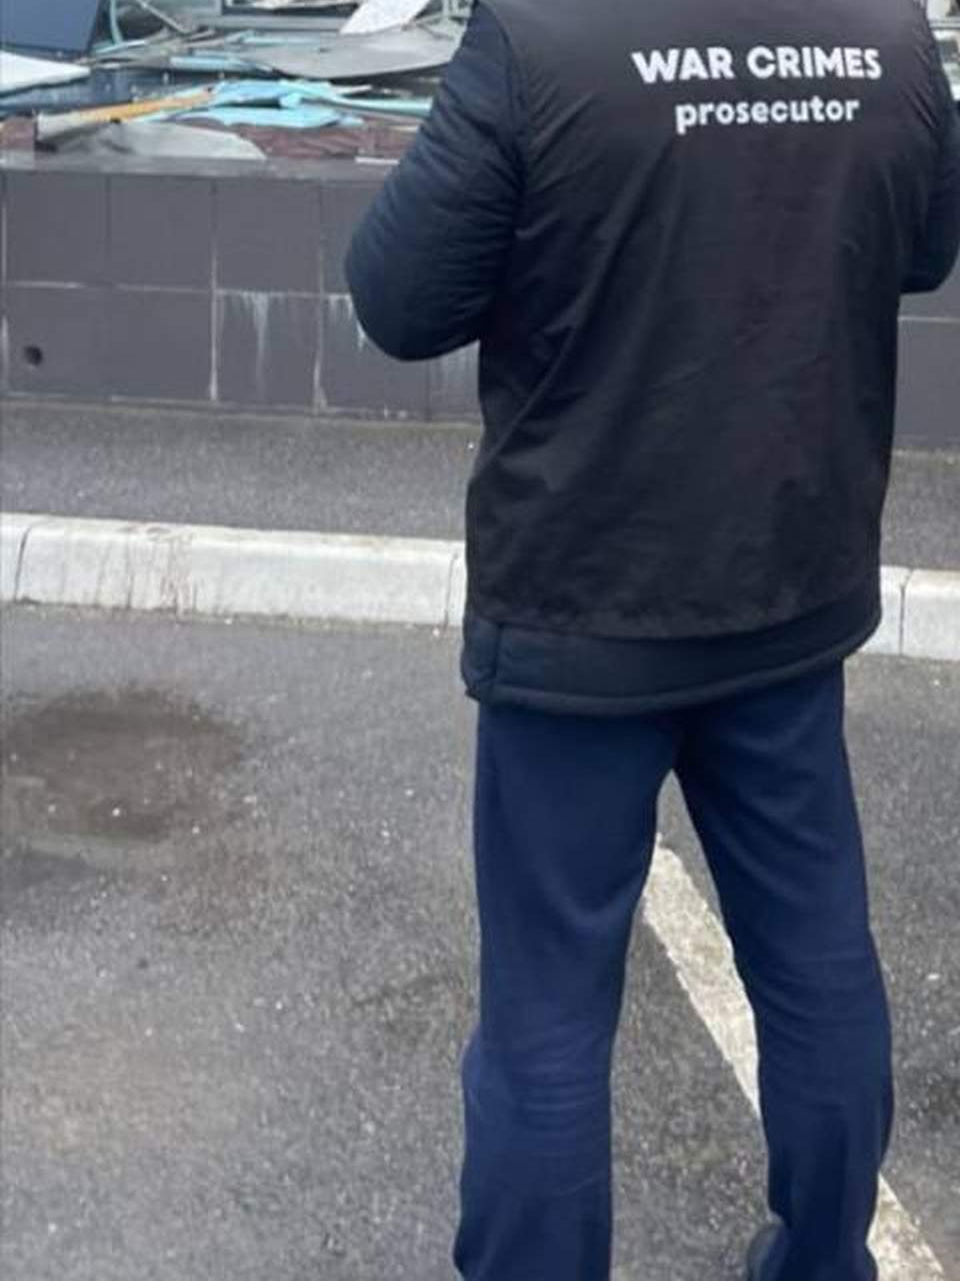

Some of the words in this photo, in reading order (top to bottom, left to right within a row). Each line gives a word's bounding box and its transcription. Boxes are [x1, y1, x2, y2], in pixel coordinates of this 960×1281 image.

[631, 46, 735, 83] WAR
[746, 45, 882, 80] CRIMES
[675, 95, 860, 135] prosecutor
